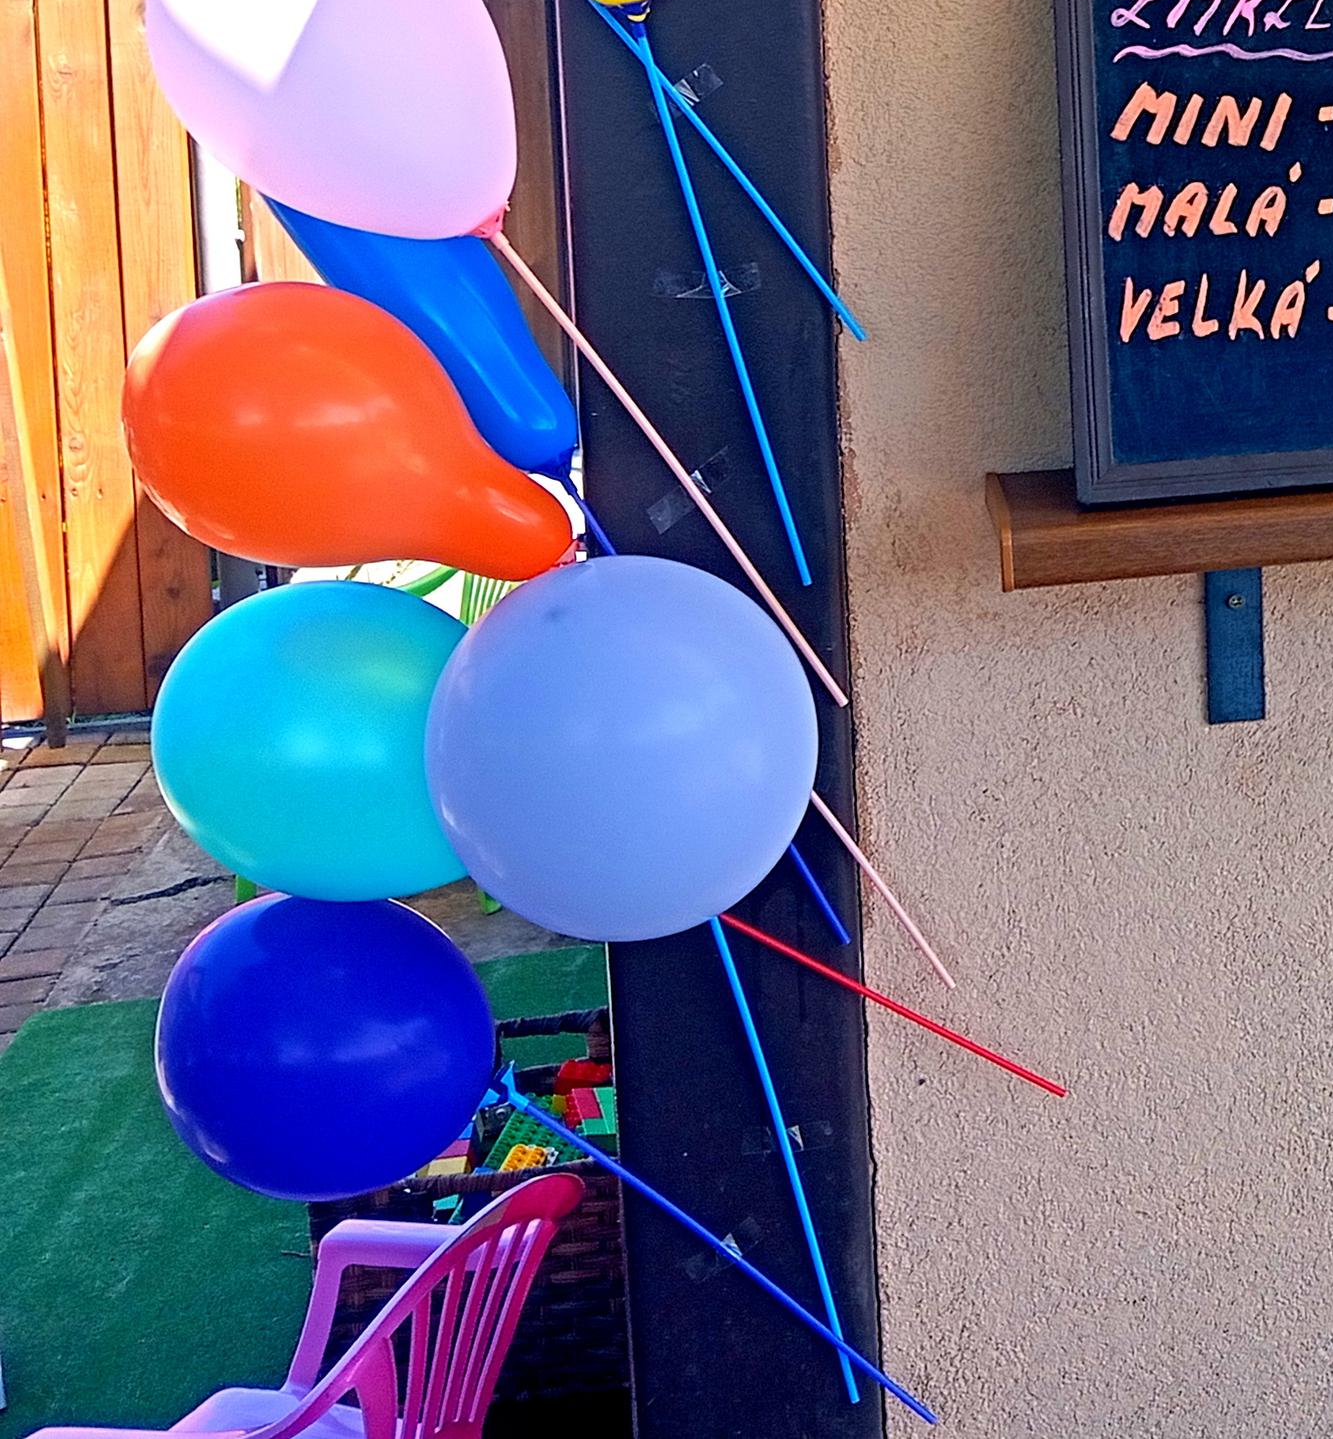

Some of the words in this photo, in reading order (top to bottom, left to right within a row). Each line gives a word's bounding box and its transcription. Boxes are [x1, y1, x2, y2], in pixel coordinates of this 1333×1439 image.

[1109, 81, 1293, 152] MINI
[1108, 161, 1302, 242] MALÁ
[1117, 259, 1321, 344] VELKÁ
